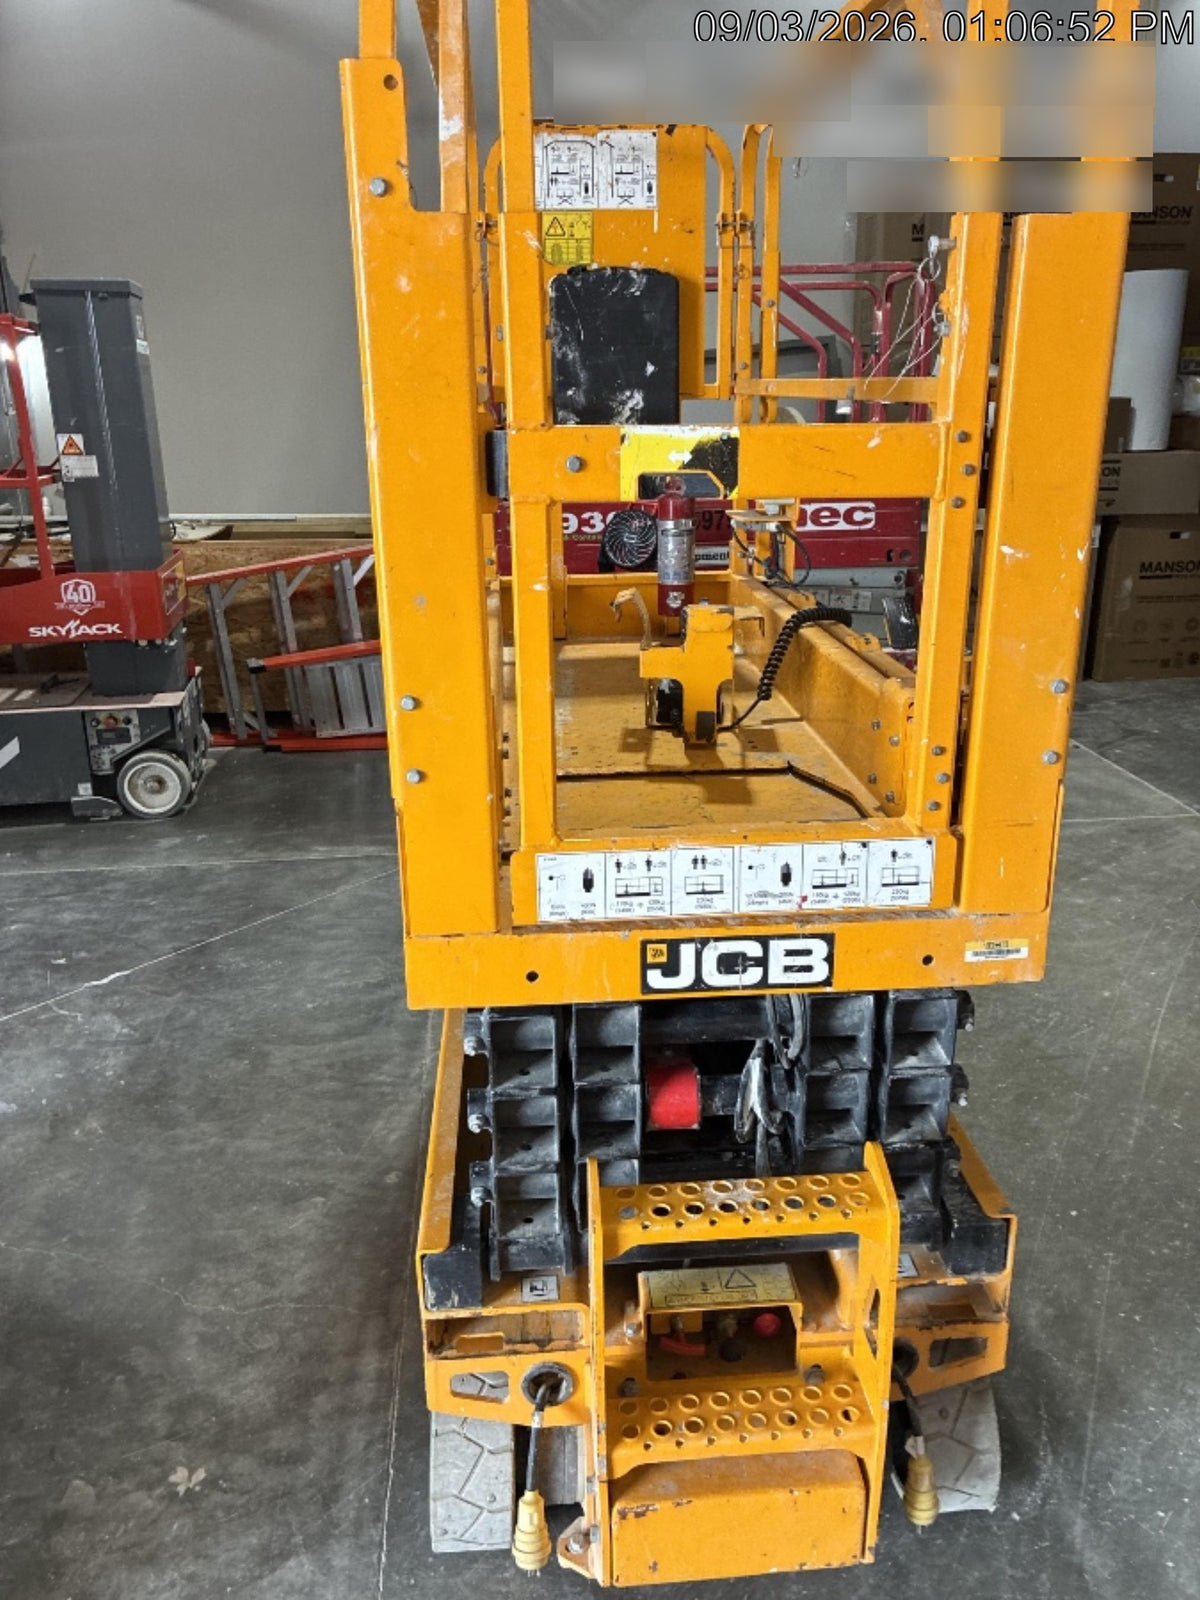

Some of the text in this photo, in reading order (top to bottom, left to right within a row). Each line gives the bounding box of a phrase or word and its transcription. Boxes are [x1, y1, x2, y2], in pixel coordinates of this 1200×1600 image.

[1131, 206, 1193, 219] ANSON
[66, 583, 92, 603] 40
[27, 618, 123, 639] SKYJACK
[646, 937, 830, 990] JCB
